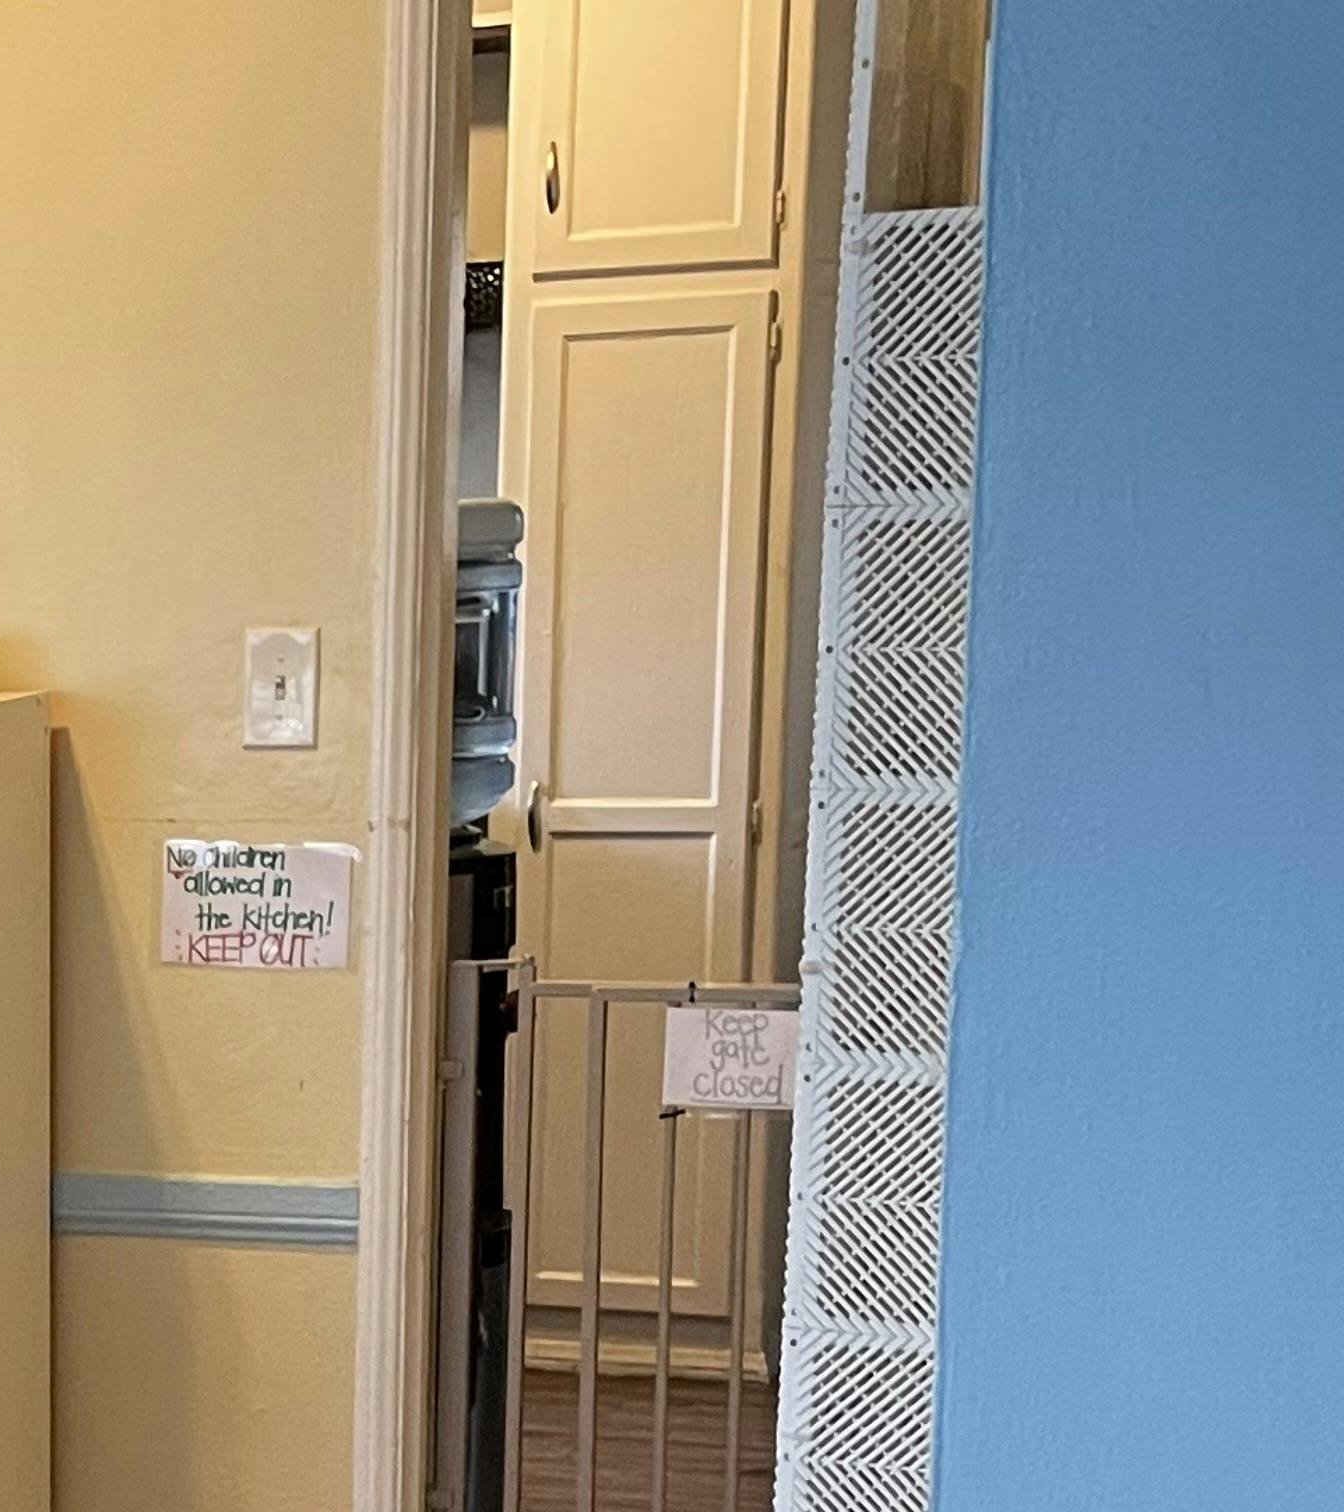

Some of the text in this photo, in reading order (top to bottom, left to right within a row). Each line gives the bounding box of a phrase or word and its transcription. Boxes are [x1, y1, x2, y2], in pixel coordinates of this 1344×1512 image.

[167, 846, 197, 872] No
[184, 872, 292, 898] allowed in
[195, 903, 232, 931] the
[188, 930, 313, 967] KEEP OUT
[709, 1039, 770, 1071] gate
[693, 1064, 783, 1104] closed
